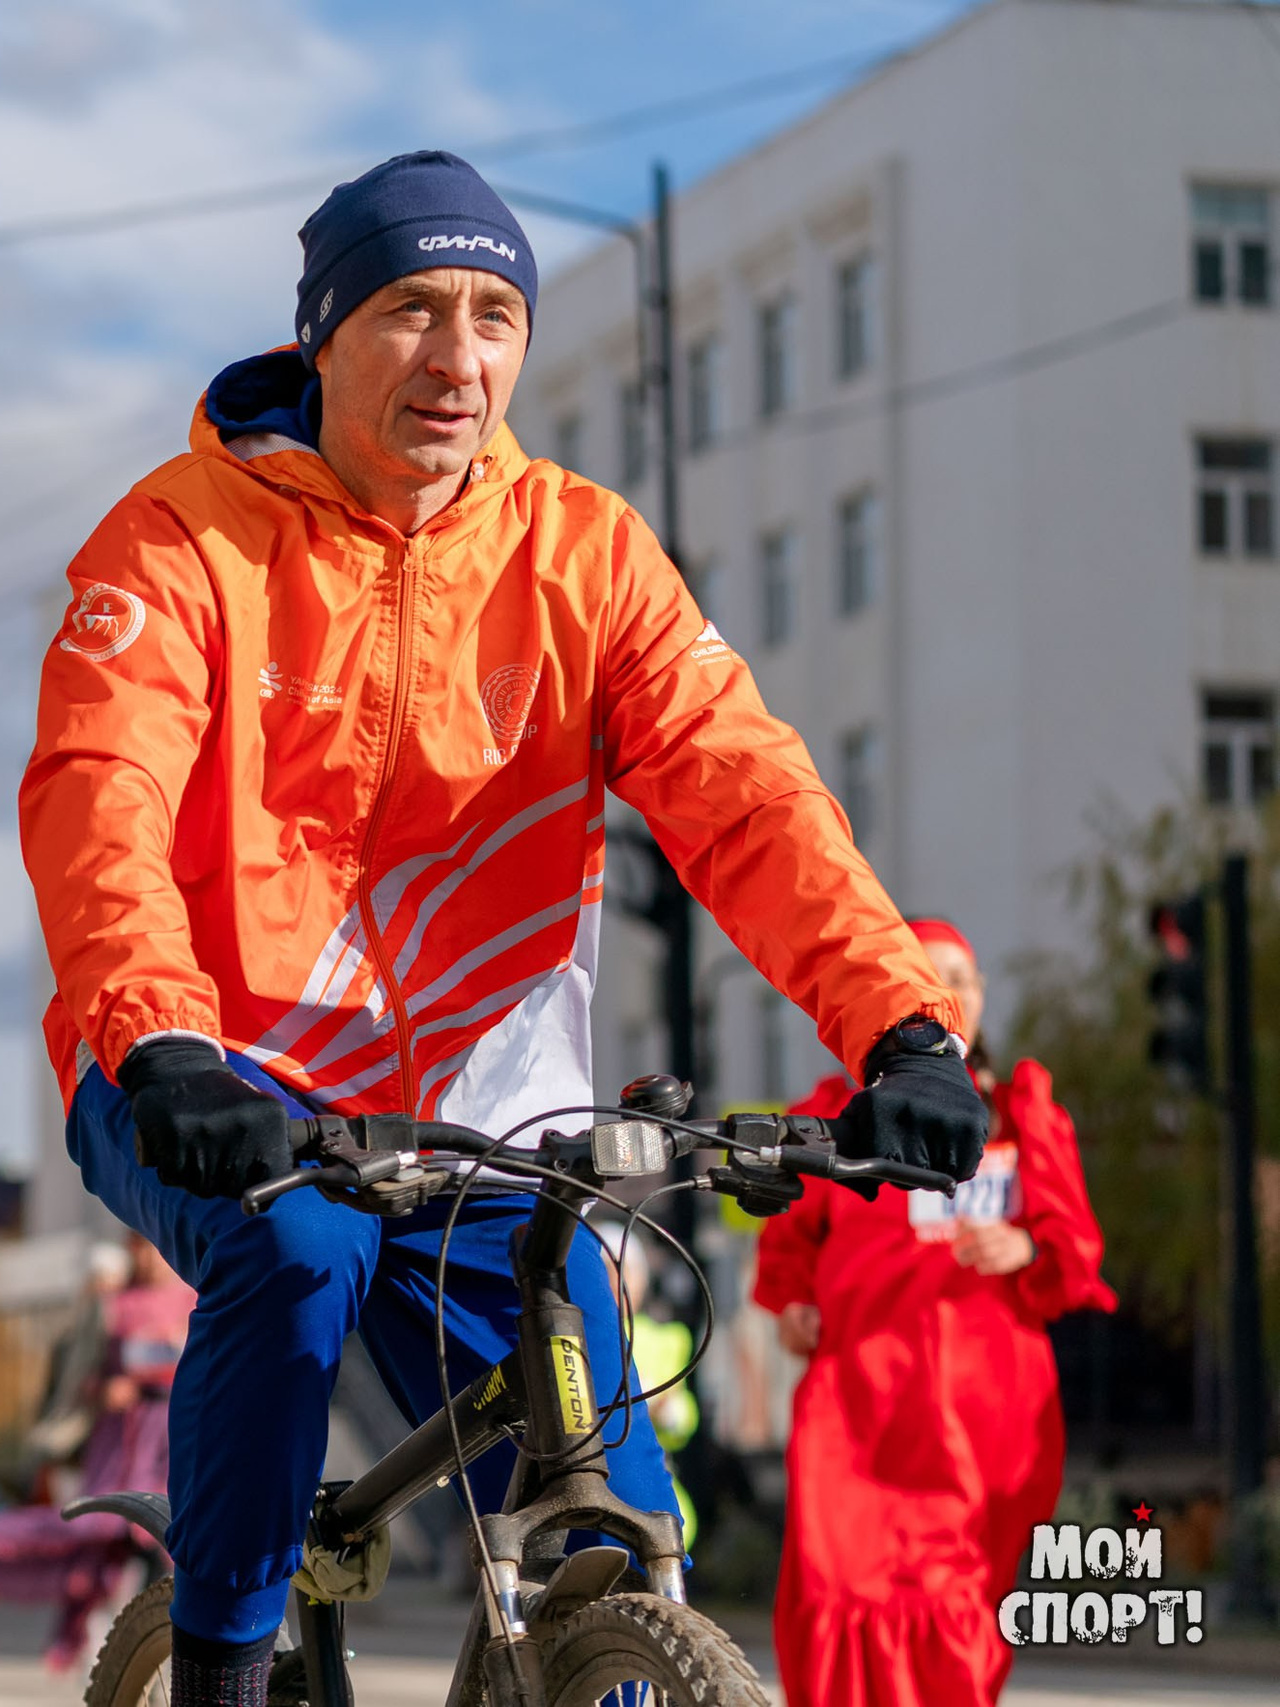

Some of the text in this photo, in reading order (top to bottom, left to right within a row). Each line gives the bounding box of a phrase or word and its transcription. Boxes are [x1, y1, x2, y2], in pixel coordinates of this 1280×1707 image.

[322, 696, 342, 704] Asia
[483, 747, 507, 766] RIC
[560, 1338, 587, 1430] DENTON
